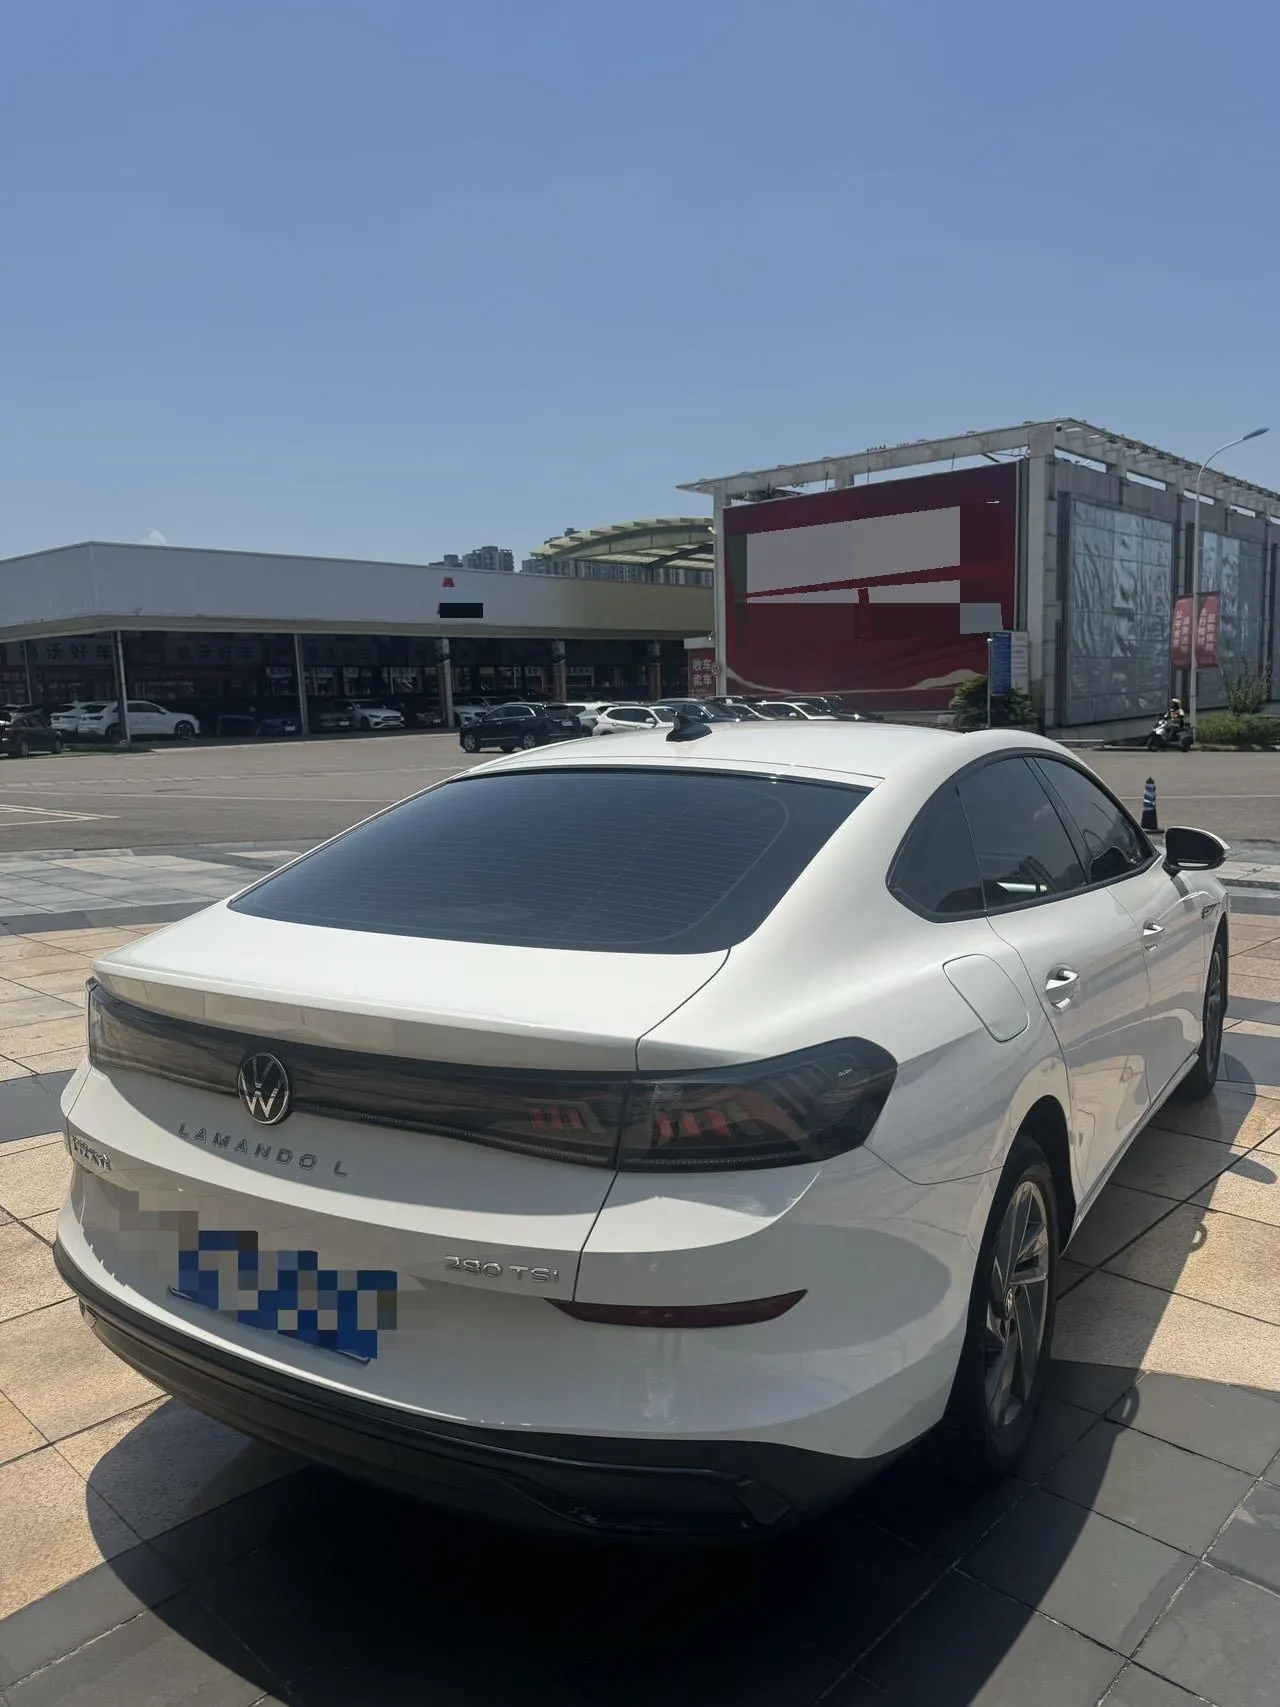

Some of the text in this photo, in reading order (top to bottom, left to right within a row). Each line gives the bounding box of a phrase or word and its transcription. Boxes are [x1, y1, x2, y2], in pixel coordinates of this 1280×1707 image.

[177, 1122, 348, 1178] LAMANDO L
[444, 1255, 560, 1284] 280 TSI
